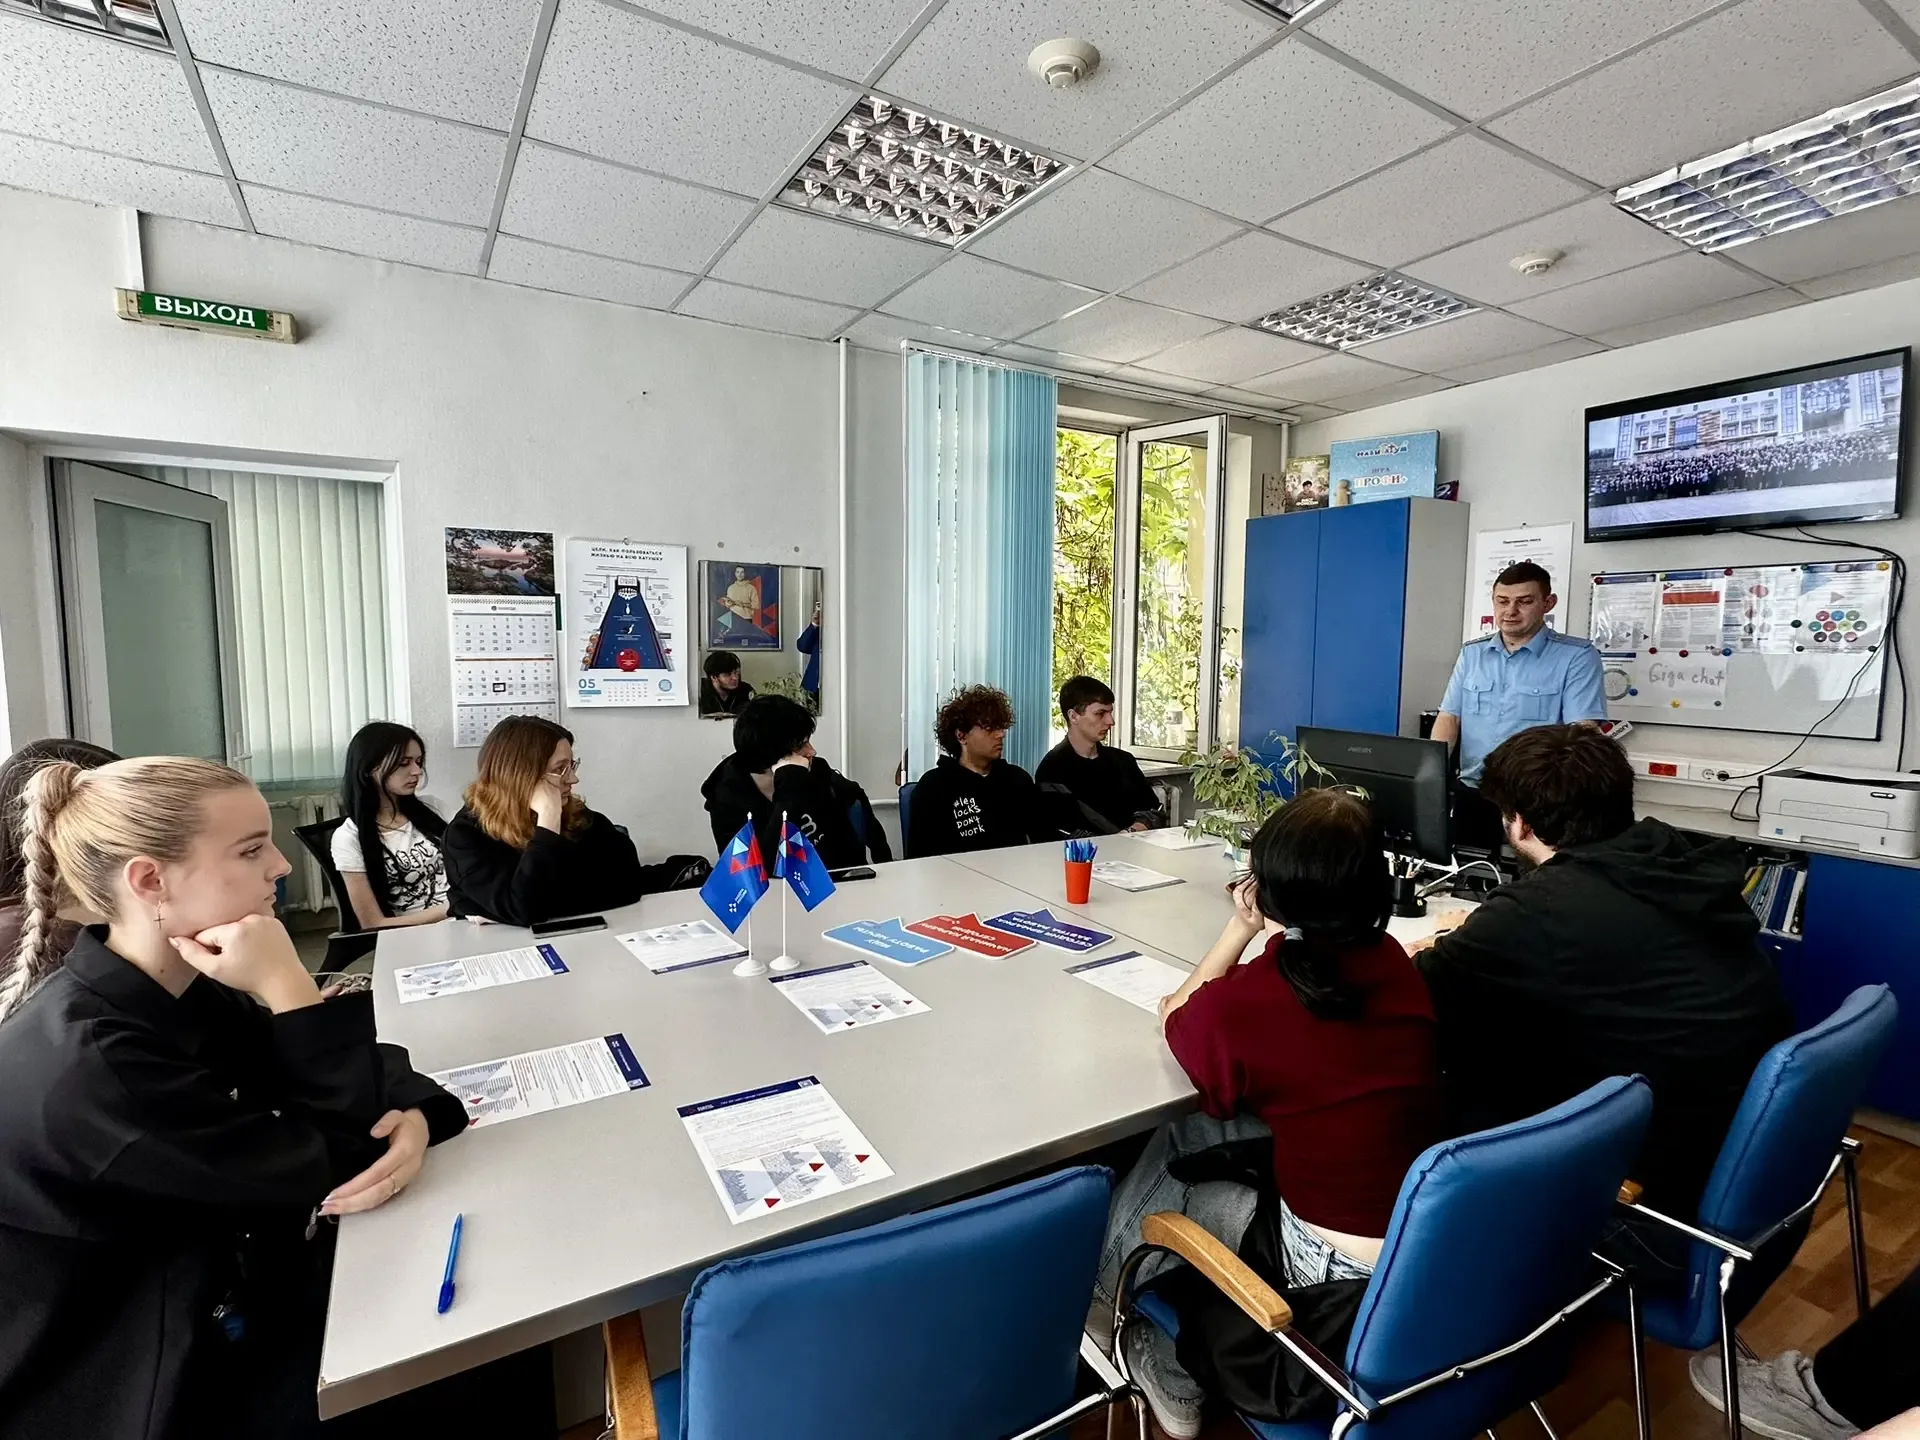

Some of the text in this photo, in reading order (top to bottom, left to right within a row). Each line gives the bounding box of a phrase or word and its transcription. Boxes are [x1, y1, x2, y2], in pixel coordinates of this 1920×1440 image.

[154, 295, 256, 327] ВЫХОД
[1648, 662, 1685, 688] Giga
[578, 678, 596, 688] 05
[953, 796, 976, 808] #leg
[953, 804, 981, 819] locks
[960, 823, 986, 837] work
[1012, 916, 1050, 930] РАБОТА
[852, 926, 930, 954] РАБОТУ МЕЧТЫ
[920, 922, 1012, 952] НАЧИНАЙ КАРЬЕРУ
[1044, 932, 1093, 947] СЕГОДНЯ
[1052, 928, 1092, 940] ЗАВТРА
